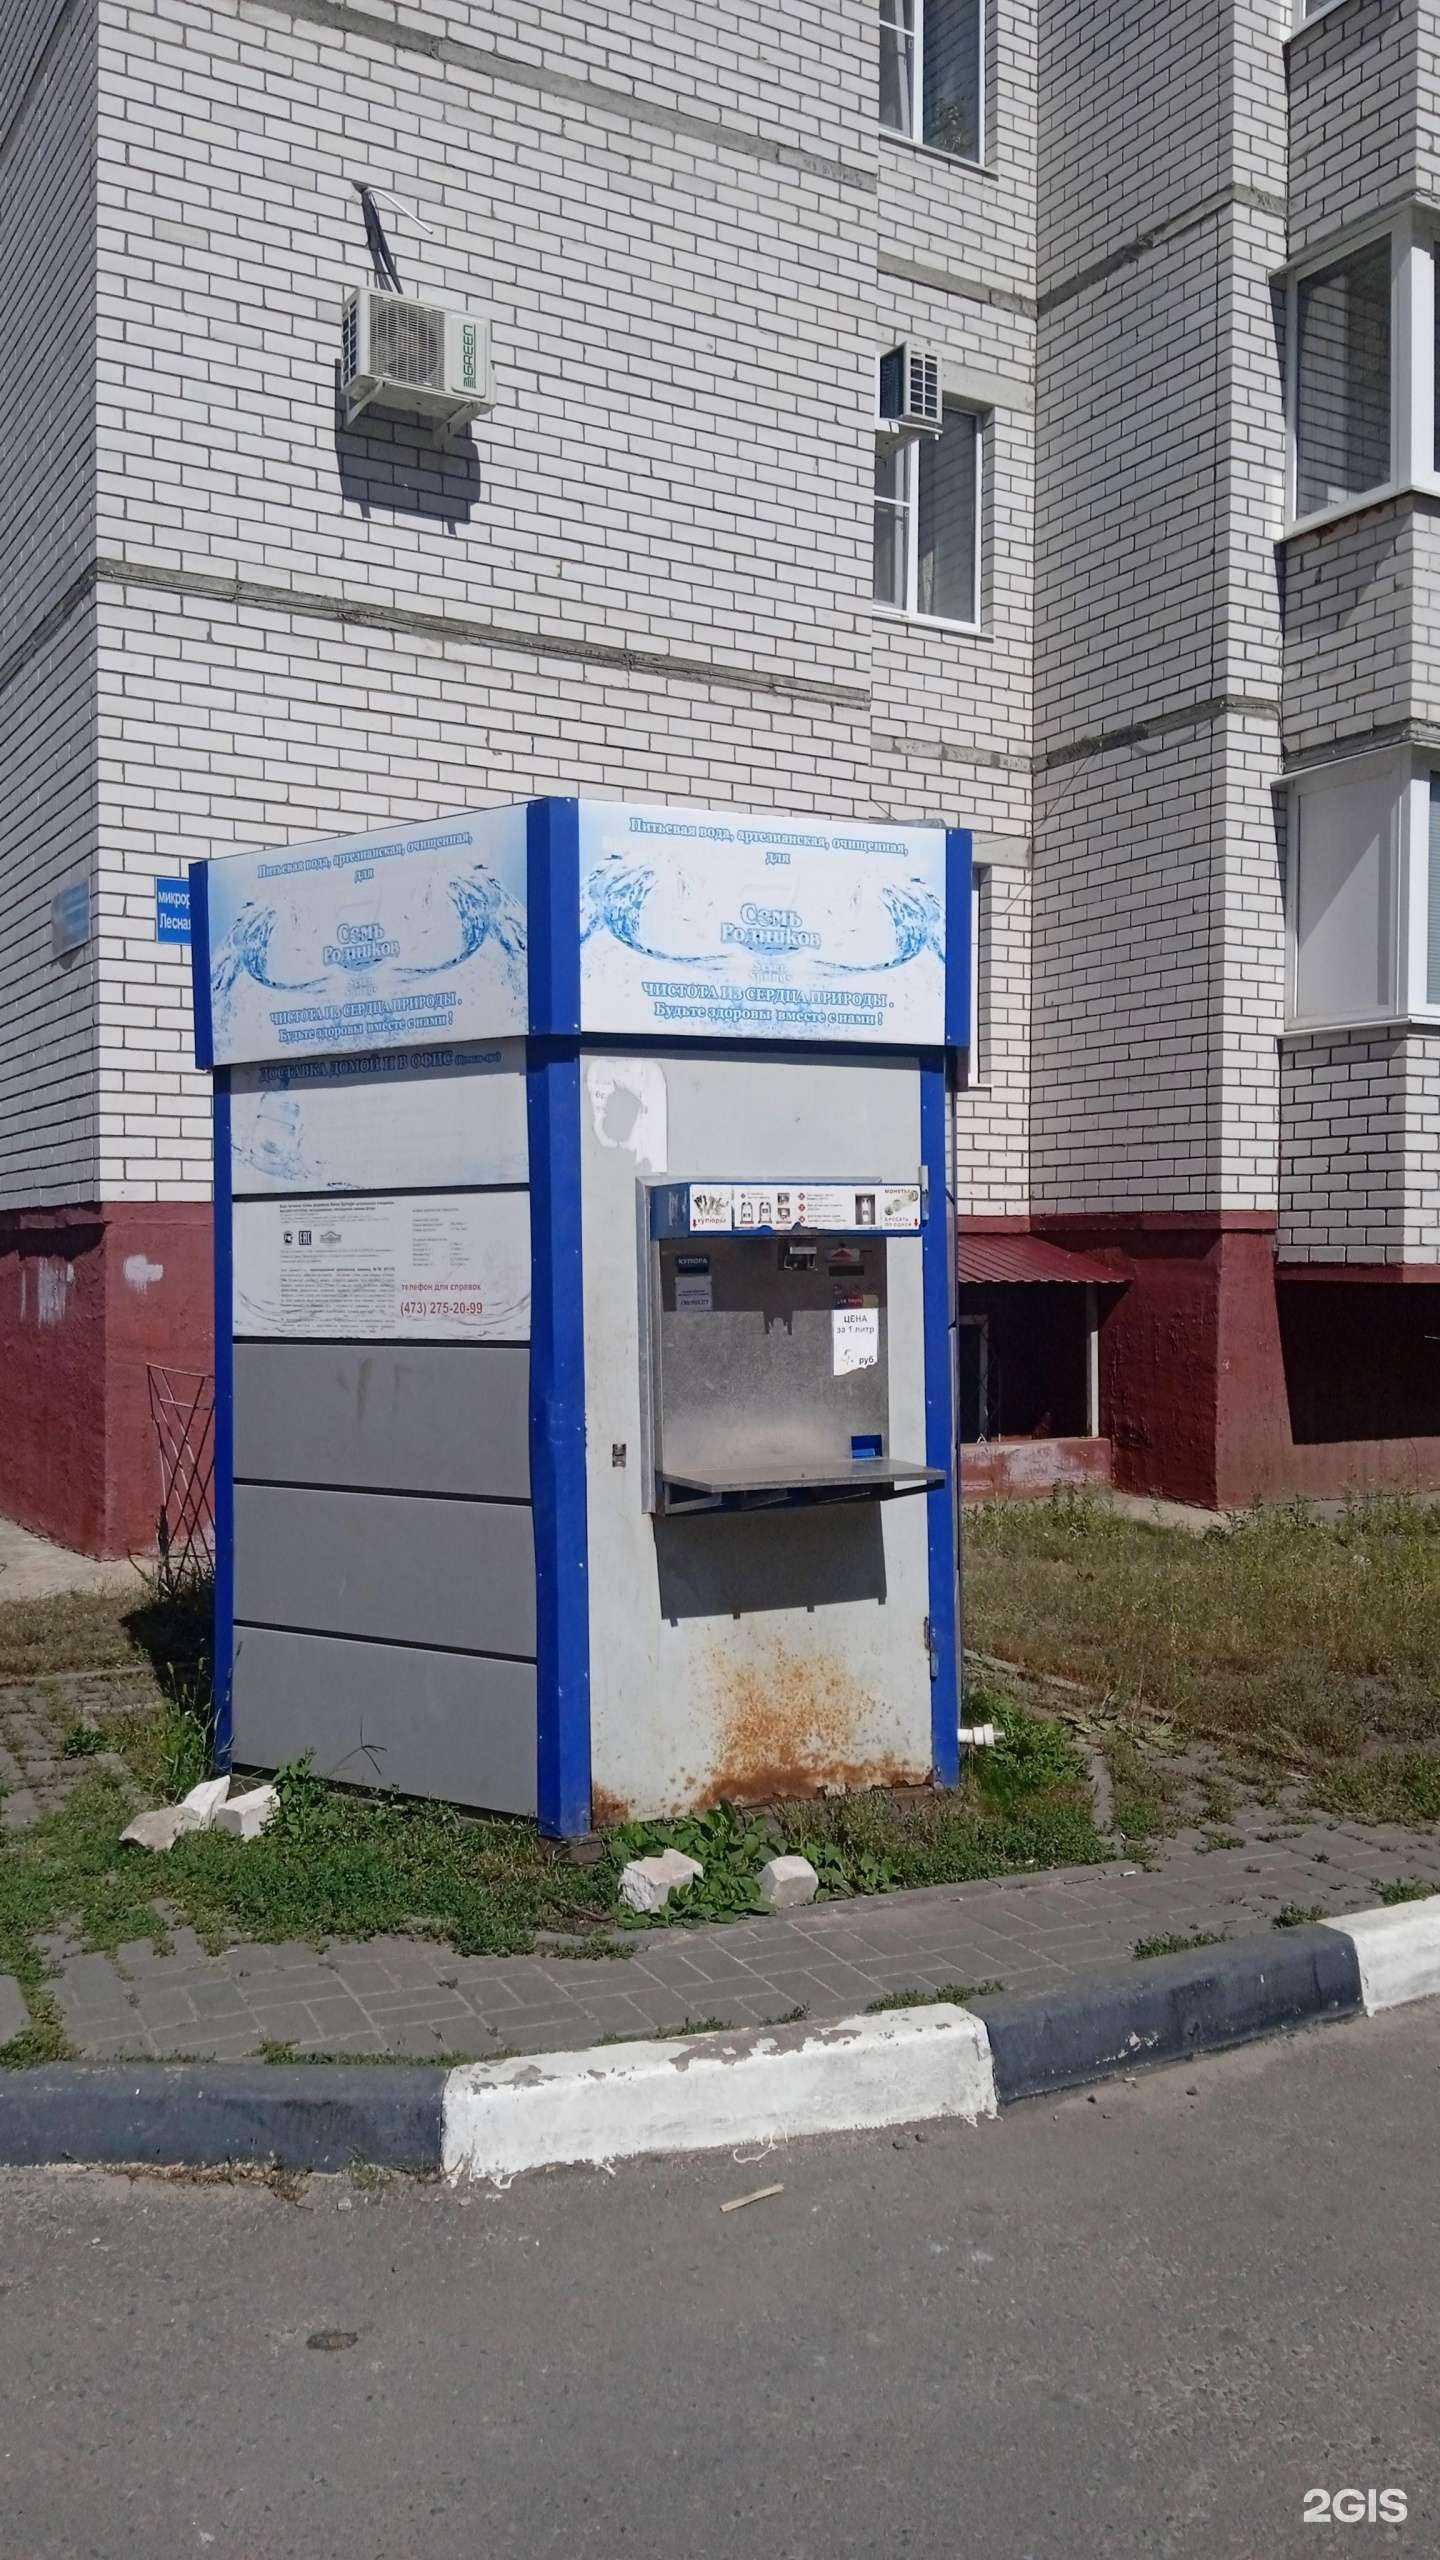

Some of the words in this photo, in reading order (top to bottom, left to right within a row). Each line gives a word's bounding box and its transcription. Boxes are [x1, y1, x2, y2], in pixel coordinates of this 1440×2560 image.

[463, 324, 473, 376] GREEN
[629, 817, 697, 837] Питьевая
[699, 826, 734, 842] вода,
[831, 837, 908, 857] очищенная,
[765, 852, 791, 865] для
[355, 868, 374, 883] для
[740, 903, 802, 928] Семь
[337, 923, 384, 944] Семь
[721, 922, 821, 950] Родников
[323, 941, 400, 967] Родников
[642, 981, 718, 1000] ЧИСТОТА
[721, 986, 744, 1001] ИЗ
[745, 987, 809, 1005] СЕРДЦА
[270, 1007, 322, 1025] ЧИСТОТА
[343, 1000, 391, 1018] СЕРДЦА
[655, 1001, 705, 1018] Будьте
[707, 1007, 771, 1022] здоровы
[776, 1008, 826, 1023] вместе
[828, 1012, 837, 1023] с
[410, 1050, 453, 1069] ОФИС
[400, 1302, 427, 1317] (473)
[430, 1302, 483, 1314] 275-20-99
[844, 1315, 867, 1324] ЦЕНА
